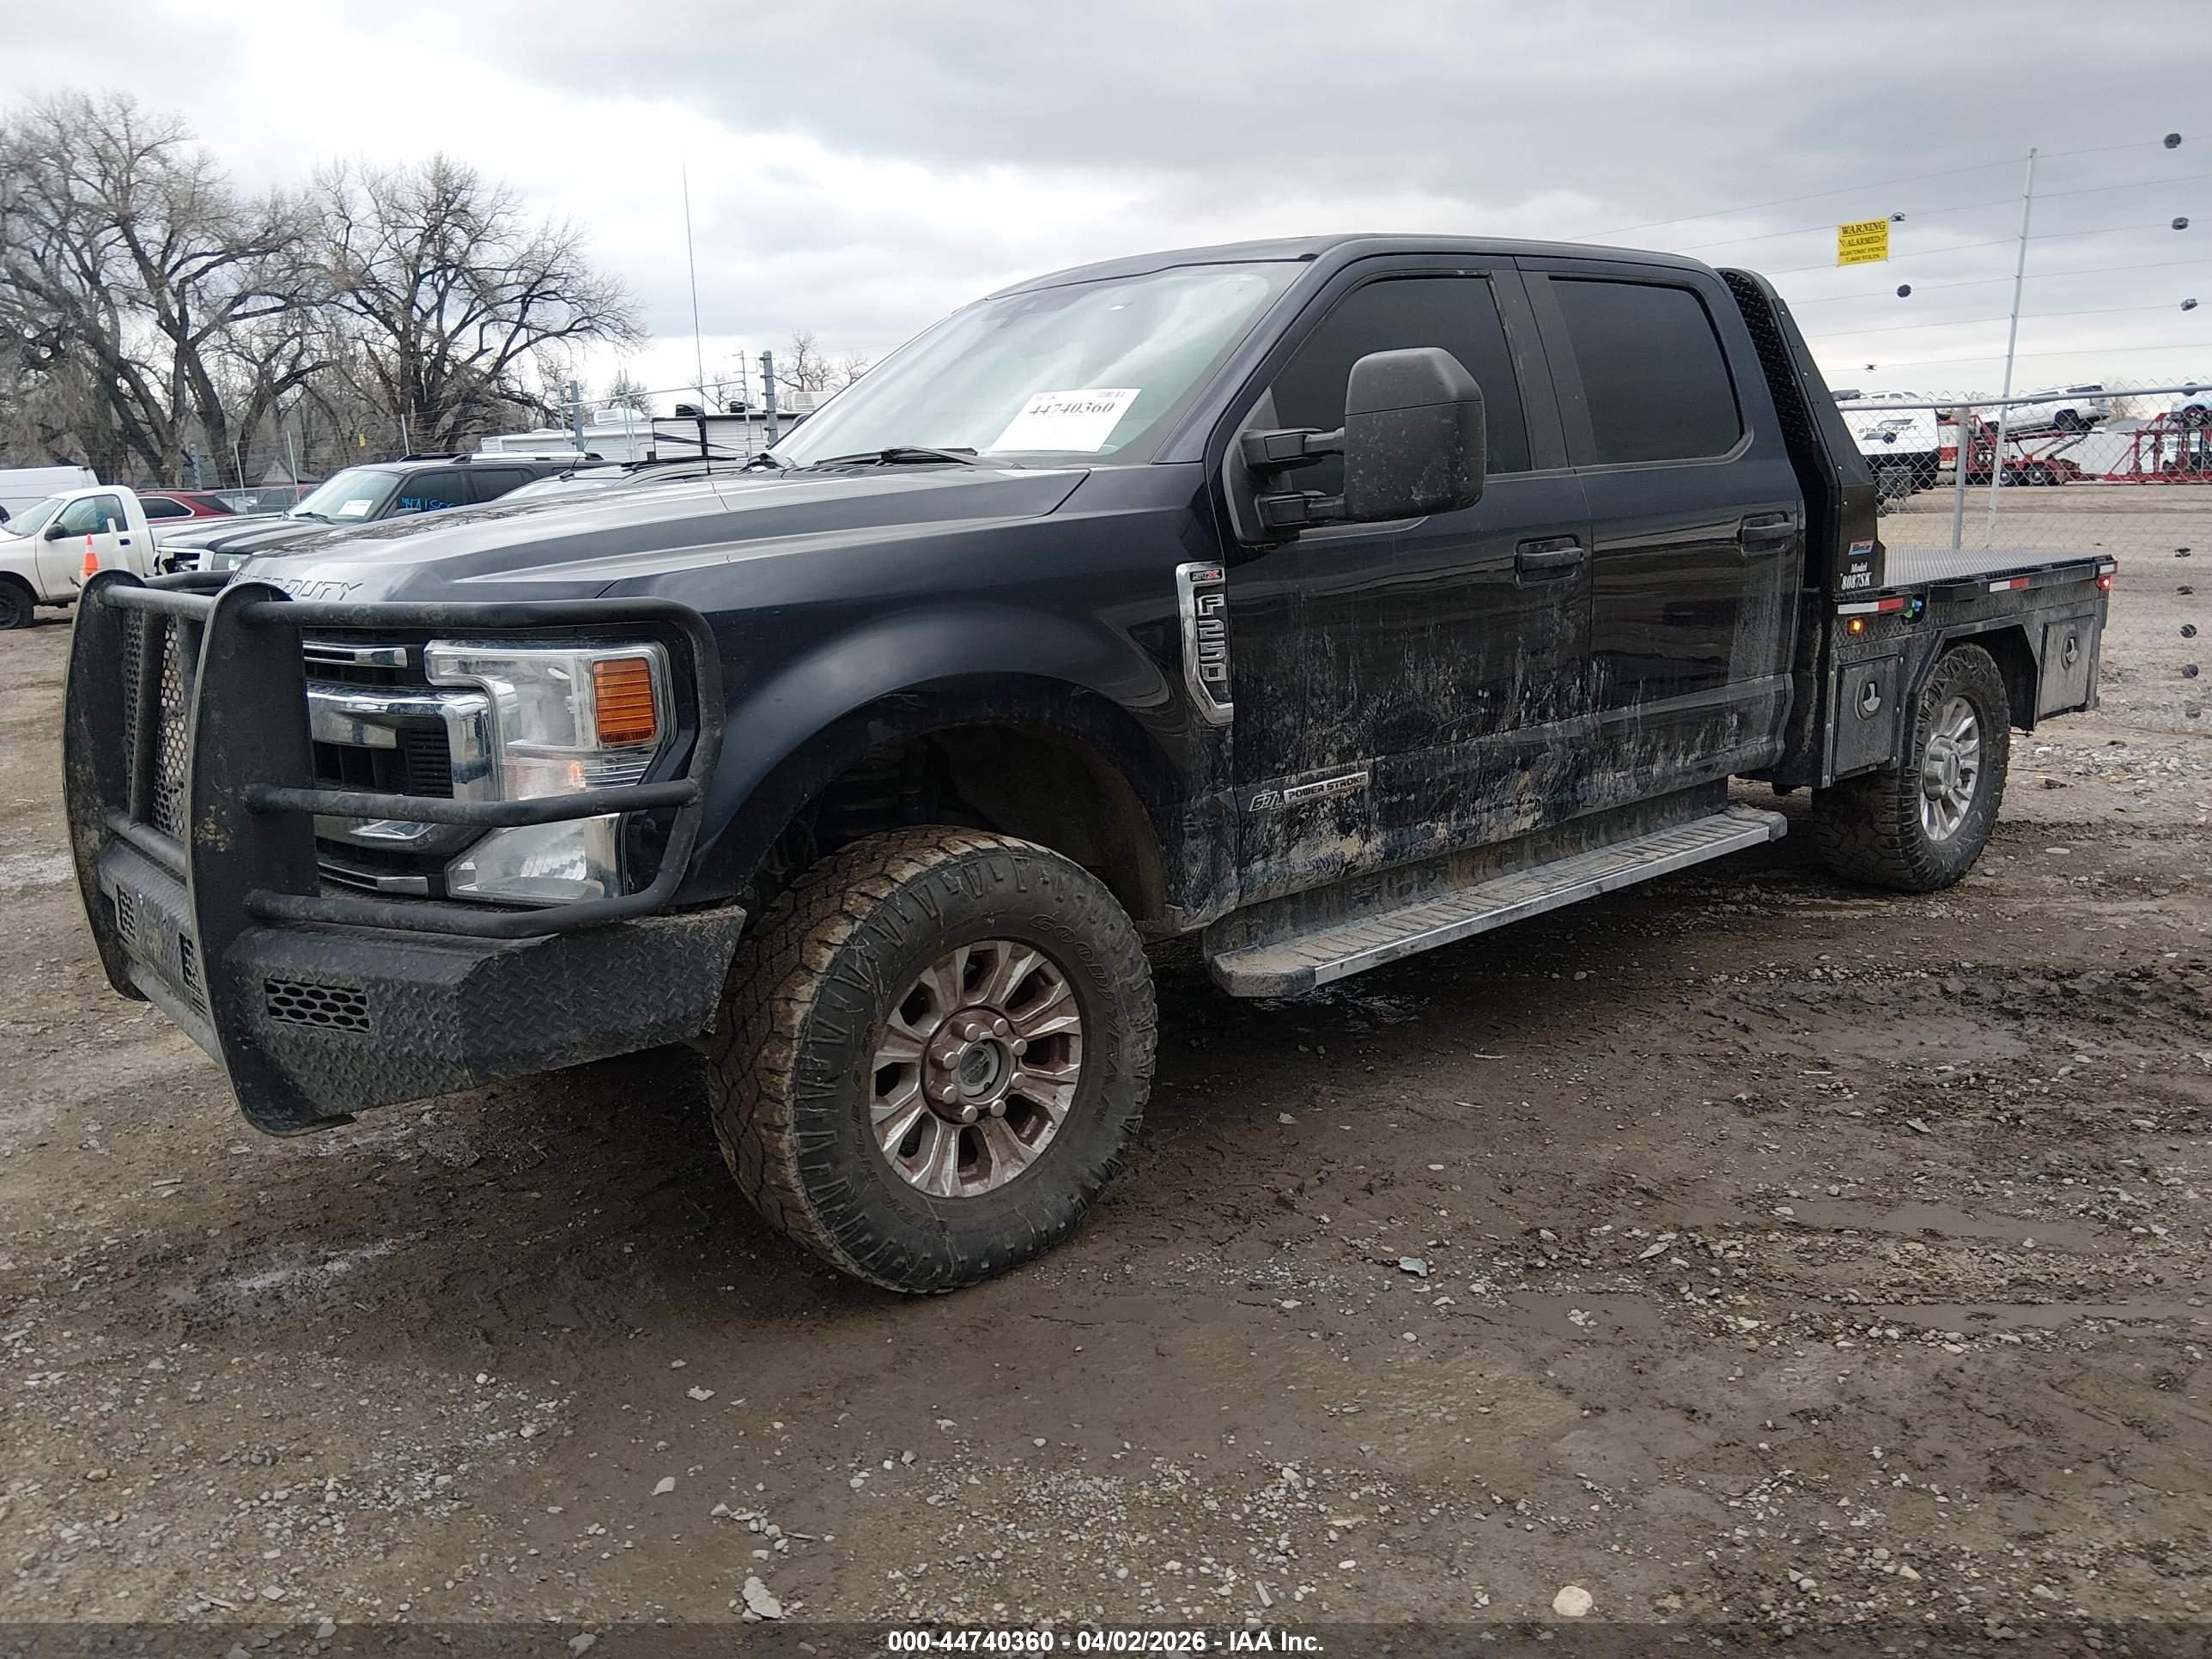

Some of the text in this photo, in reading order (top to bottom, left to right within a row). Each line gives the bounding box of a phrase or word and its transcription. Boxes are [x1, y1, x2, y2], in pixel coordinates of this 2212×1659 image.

[1842, 221, 1886, 234] WARNING
[1847, 235, 1881, 246] ALARMED
[1030, 402, 1115, 415] 44740360
[1850, 562, 1868, 573] Model
[1192, 570, 1221, 581] STX
[1841, 572, 1872, 590] 8087SK
[283, 579, 364, 601] DUTY
[1289, 785, 1324, 799] POWER
